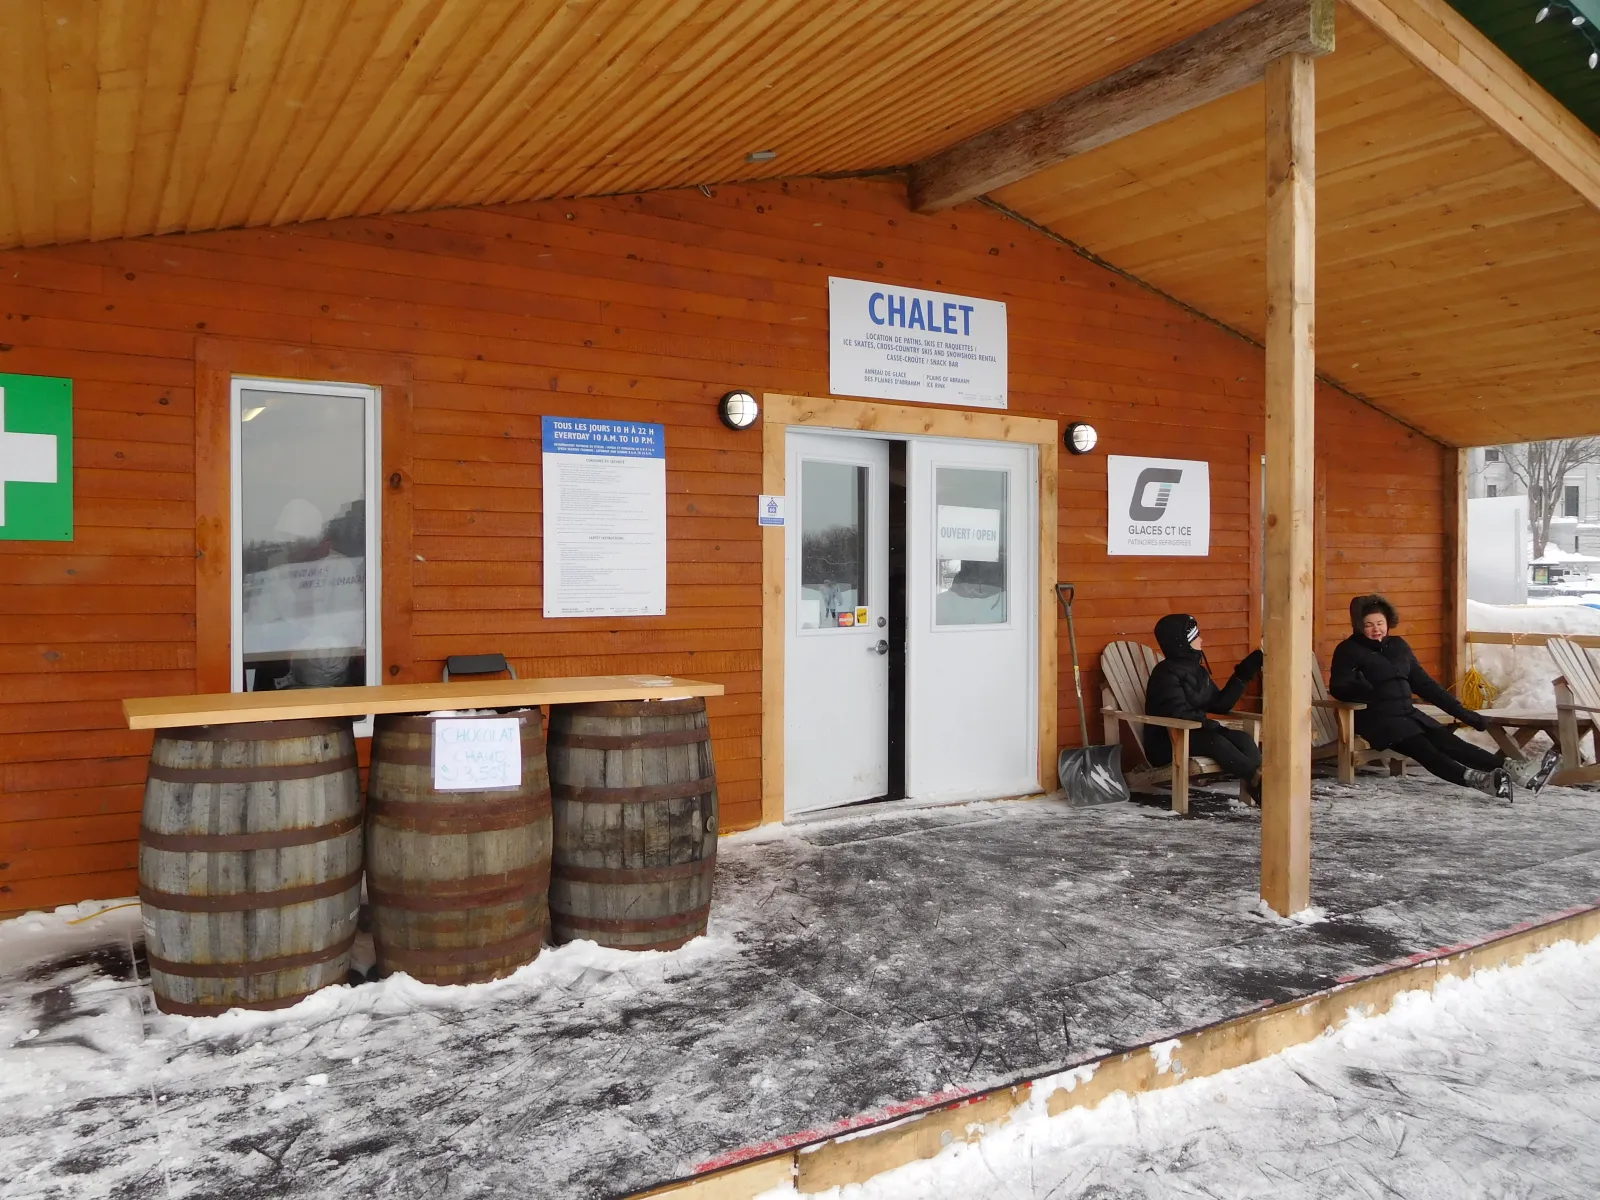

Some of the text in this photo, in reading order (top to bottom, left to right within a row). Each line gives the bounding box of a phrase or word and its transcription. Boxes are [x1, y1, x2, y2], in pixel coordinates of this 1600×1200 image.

[868, 292, 974, 336] CHALET
[866, 333, 893, 343] LOCATION
[904, 338, 922, 346] PATINS,
[945, 342, 973, 352] RAQUETTES
[854, 340, 875, 349] SKATES,
[877, 343, 919, 354] CROSS-COUNTRY
[934, 349, 944, 357] AND
[946, 351, 977, 360] SNOWSHOES
[979, 354, 997, 363] RENTAL
[886, 354, 925, 364] CASSE-CROÛTE
[930, 358, 947, 367] SNACK
[864, 368, 884, 376] ANNEAU
[875, 376, 893, 384] PLAINES
[895, 378, 921, 387] D'ABRAHAM
[553, 422, 572, 430] TOUS
[575, 423, 587, 431] LES
[589, 424, 611, 433] JOURS
[623, 426, 629, 434] H
[631, 425, 636, 434] À
[638, 427, 646, 435] 22
[649, 428, 654, 436] H
[554, 432, 655, 445] EVERYDAY 10 A.M. TO 10 P.M.
[940, 526, 971, 540] OUVERT
[976, 529, 996, 542] OPEN
[1128, 525, 1192, 536] GLACES CT ICE
[442, 727, 514, 743] CHOCOLAT
